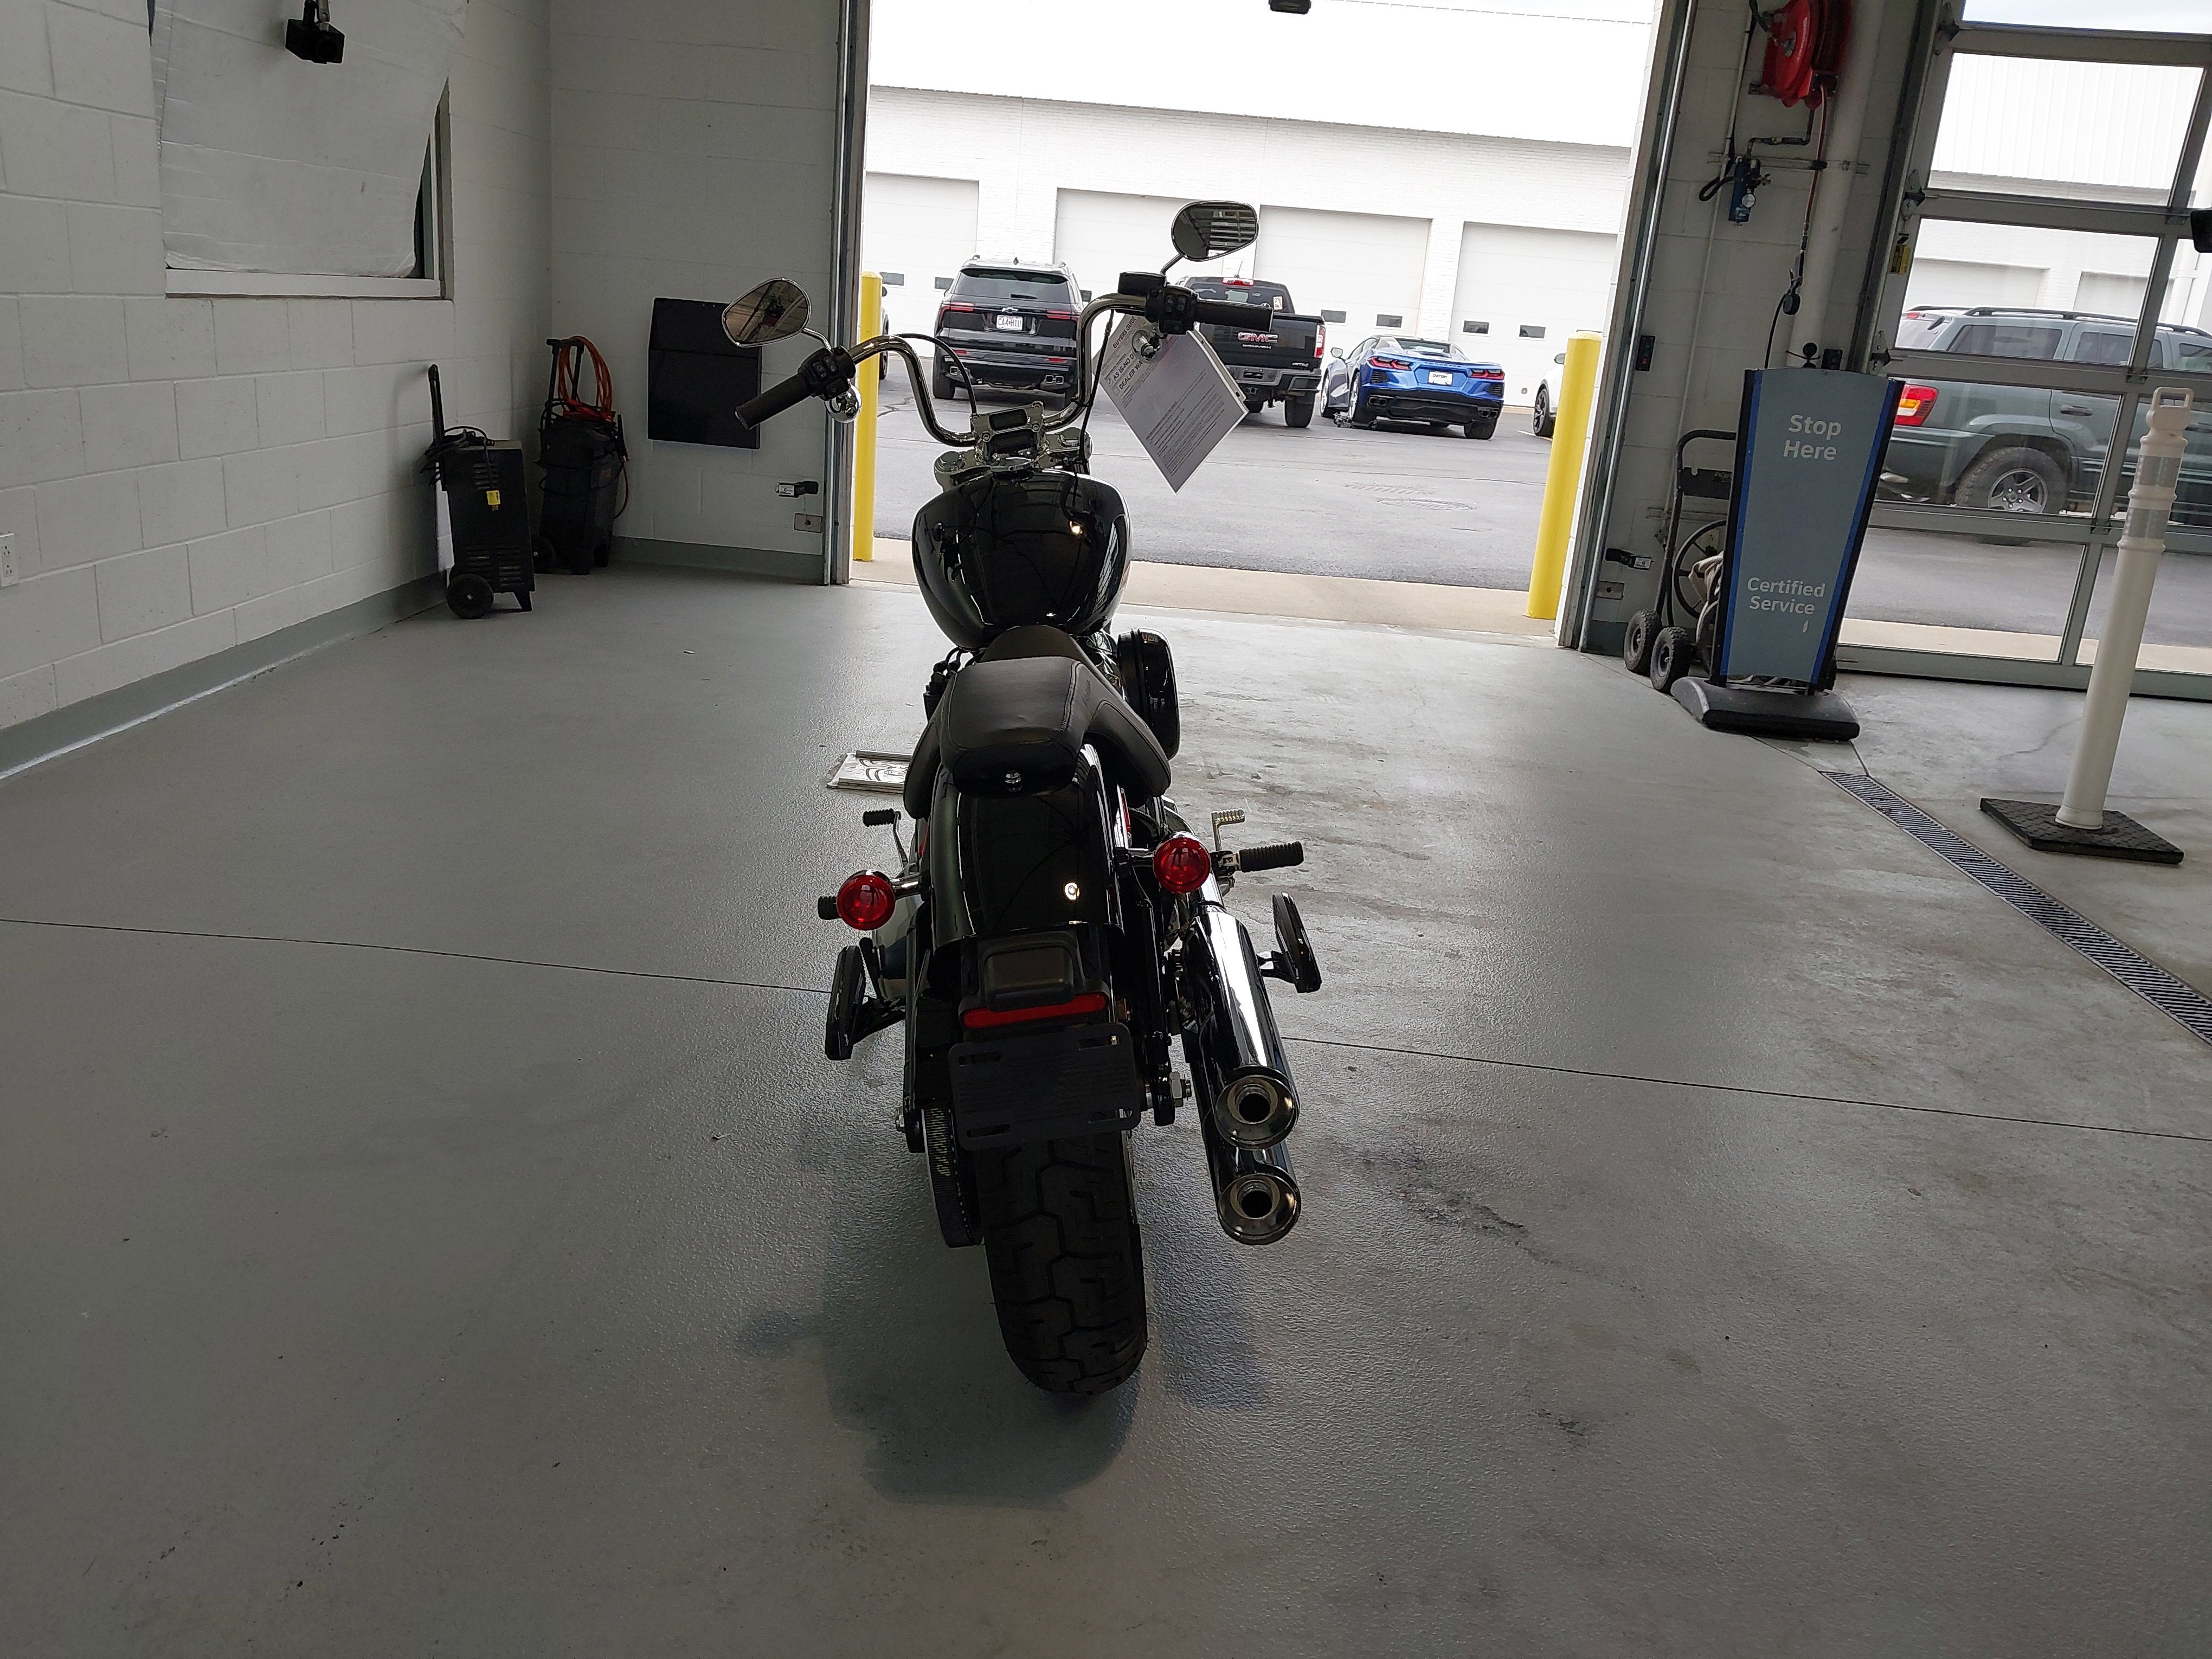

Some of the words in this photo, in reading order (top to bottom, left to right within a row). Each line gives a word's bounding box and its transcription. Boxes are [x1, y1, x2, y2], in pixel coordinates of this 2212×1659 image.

[1238, 332, 1278, 343] GMC
[1113, 371, 1120, 381] AS
[1118, 369, 1136, 390] DEALER
[1788, 414, 1842, 441] Stop
[1783, 439, 1837, 460] Here
[1747, 577, 1827, 597] Certified
[1749, 595, 1815, 615] Service
